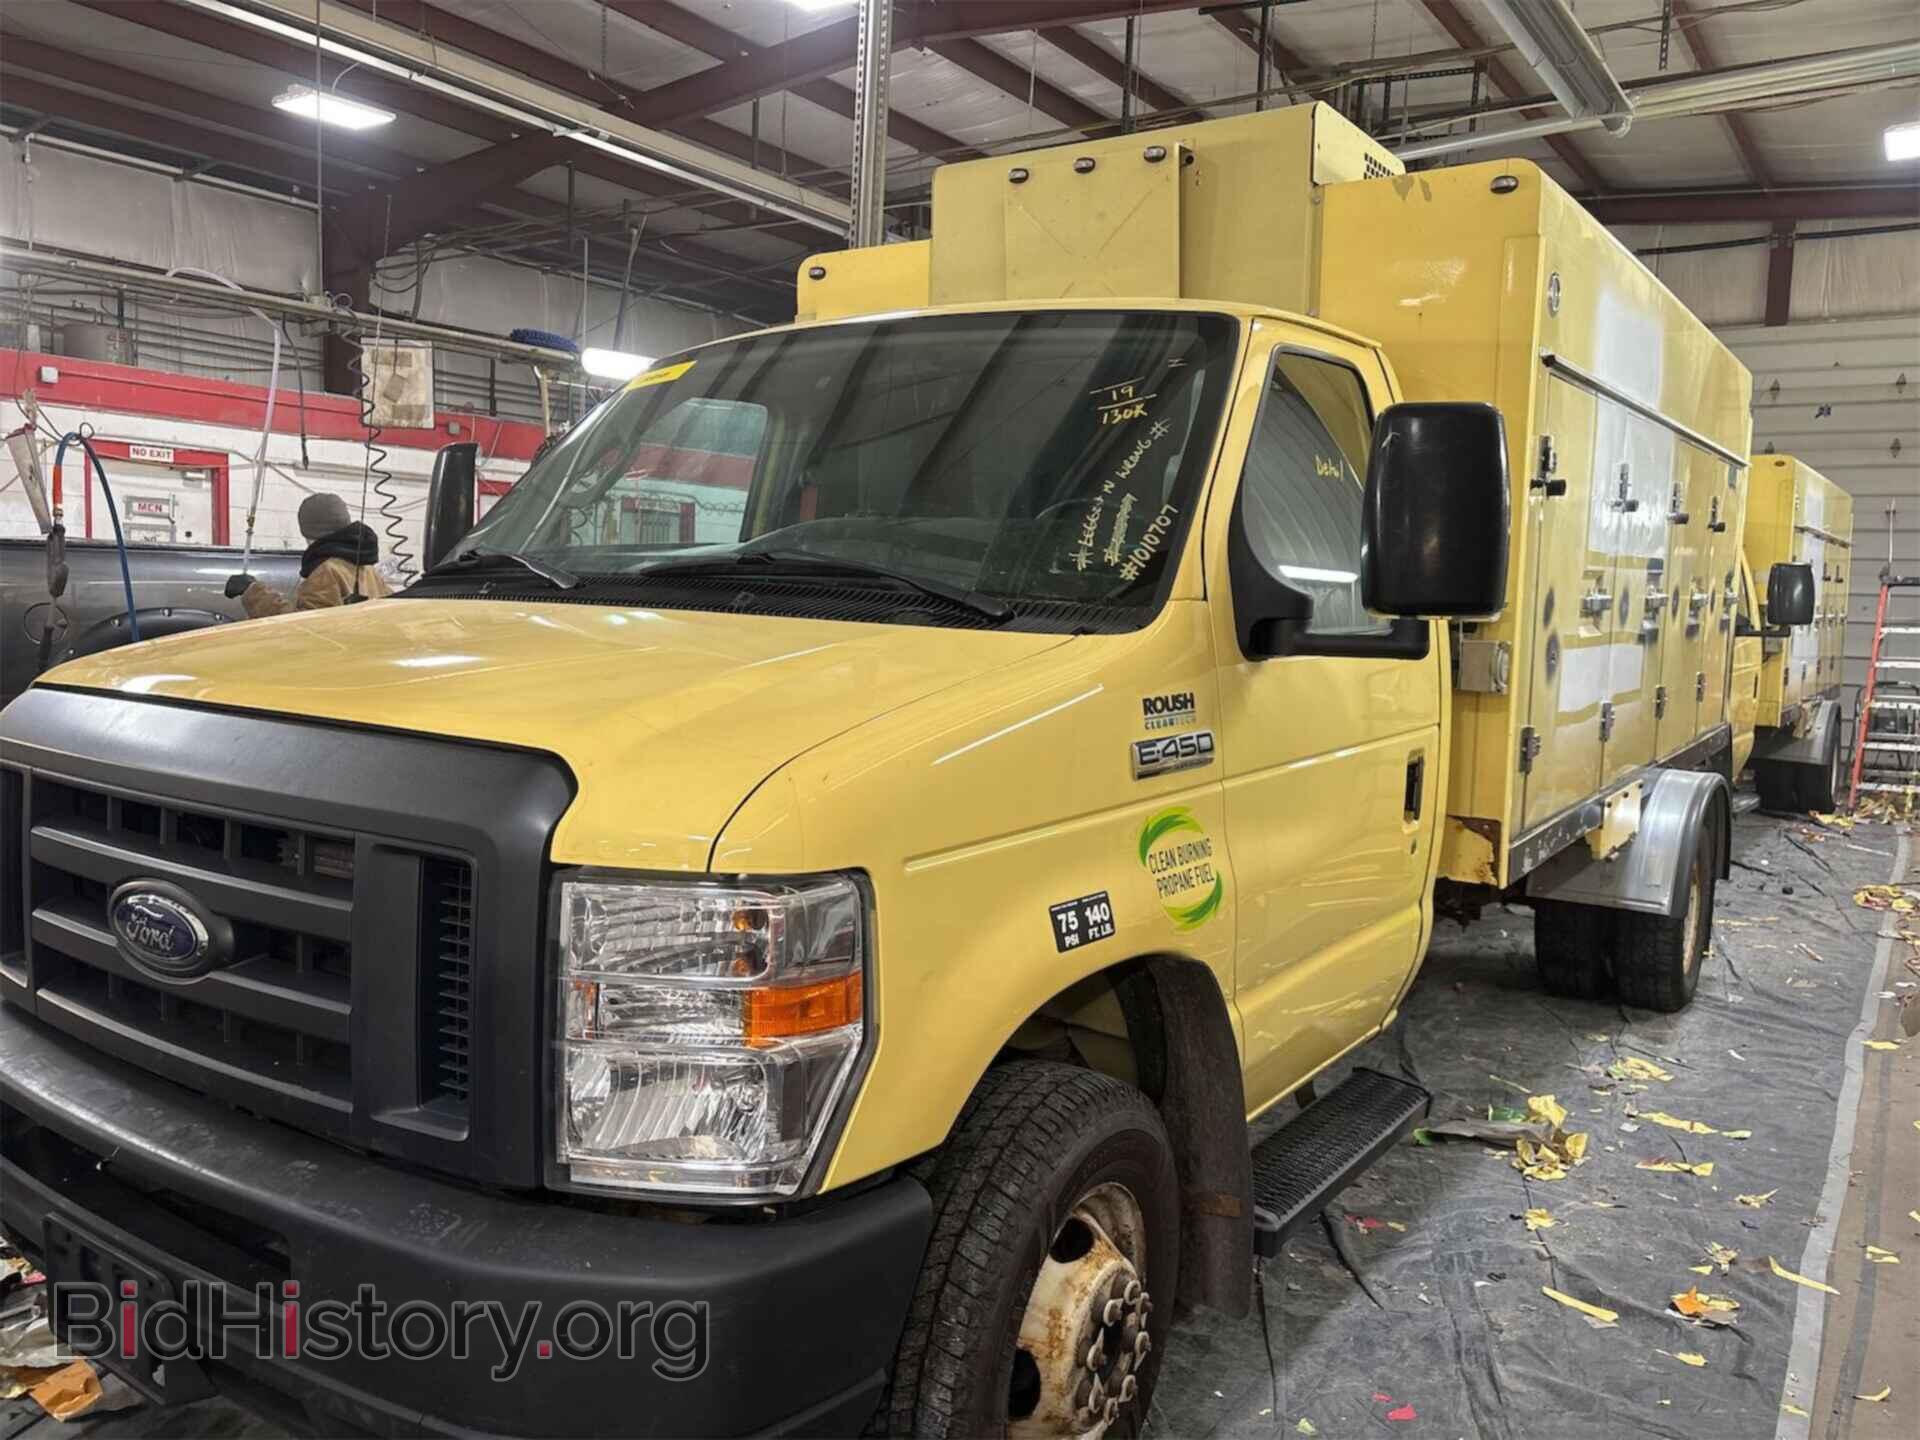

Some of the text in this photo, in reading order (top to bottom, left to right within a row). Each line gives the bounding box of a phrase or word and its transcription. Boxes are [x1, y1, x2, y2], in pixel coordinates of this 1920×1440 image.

[1112, 385, 1134, 401] 19
[132, 447, 172, 459] NO EXIT
[1119, 503, 1179, 581] #1010707
[1142, 692, 1195, 716] ROUSH
[1149, 838, 1213, 875] CLEAN BURNING
[1156, 863, 1215, 899] PROPANE FUEL
[1056, 910, 1079, 933] 75
[1084, 902, 1110, 926] 140
[125, 913, 175, 951] Ford
[1064, 932, 1080, 948] PSI
